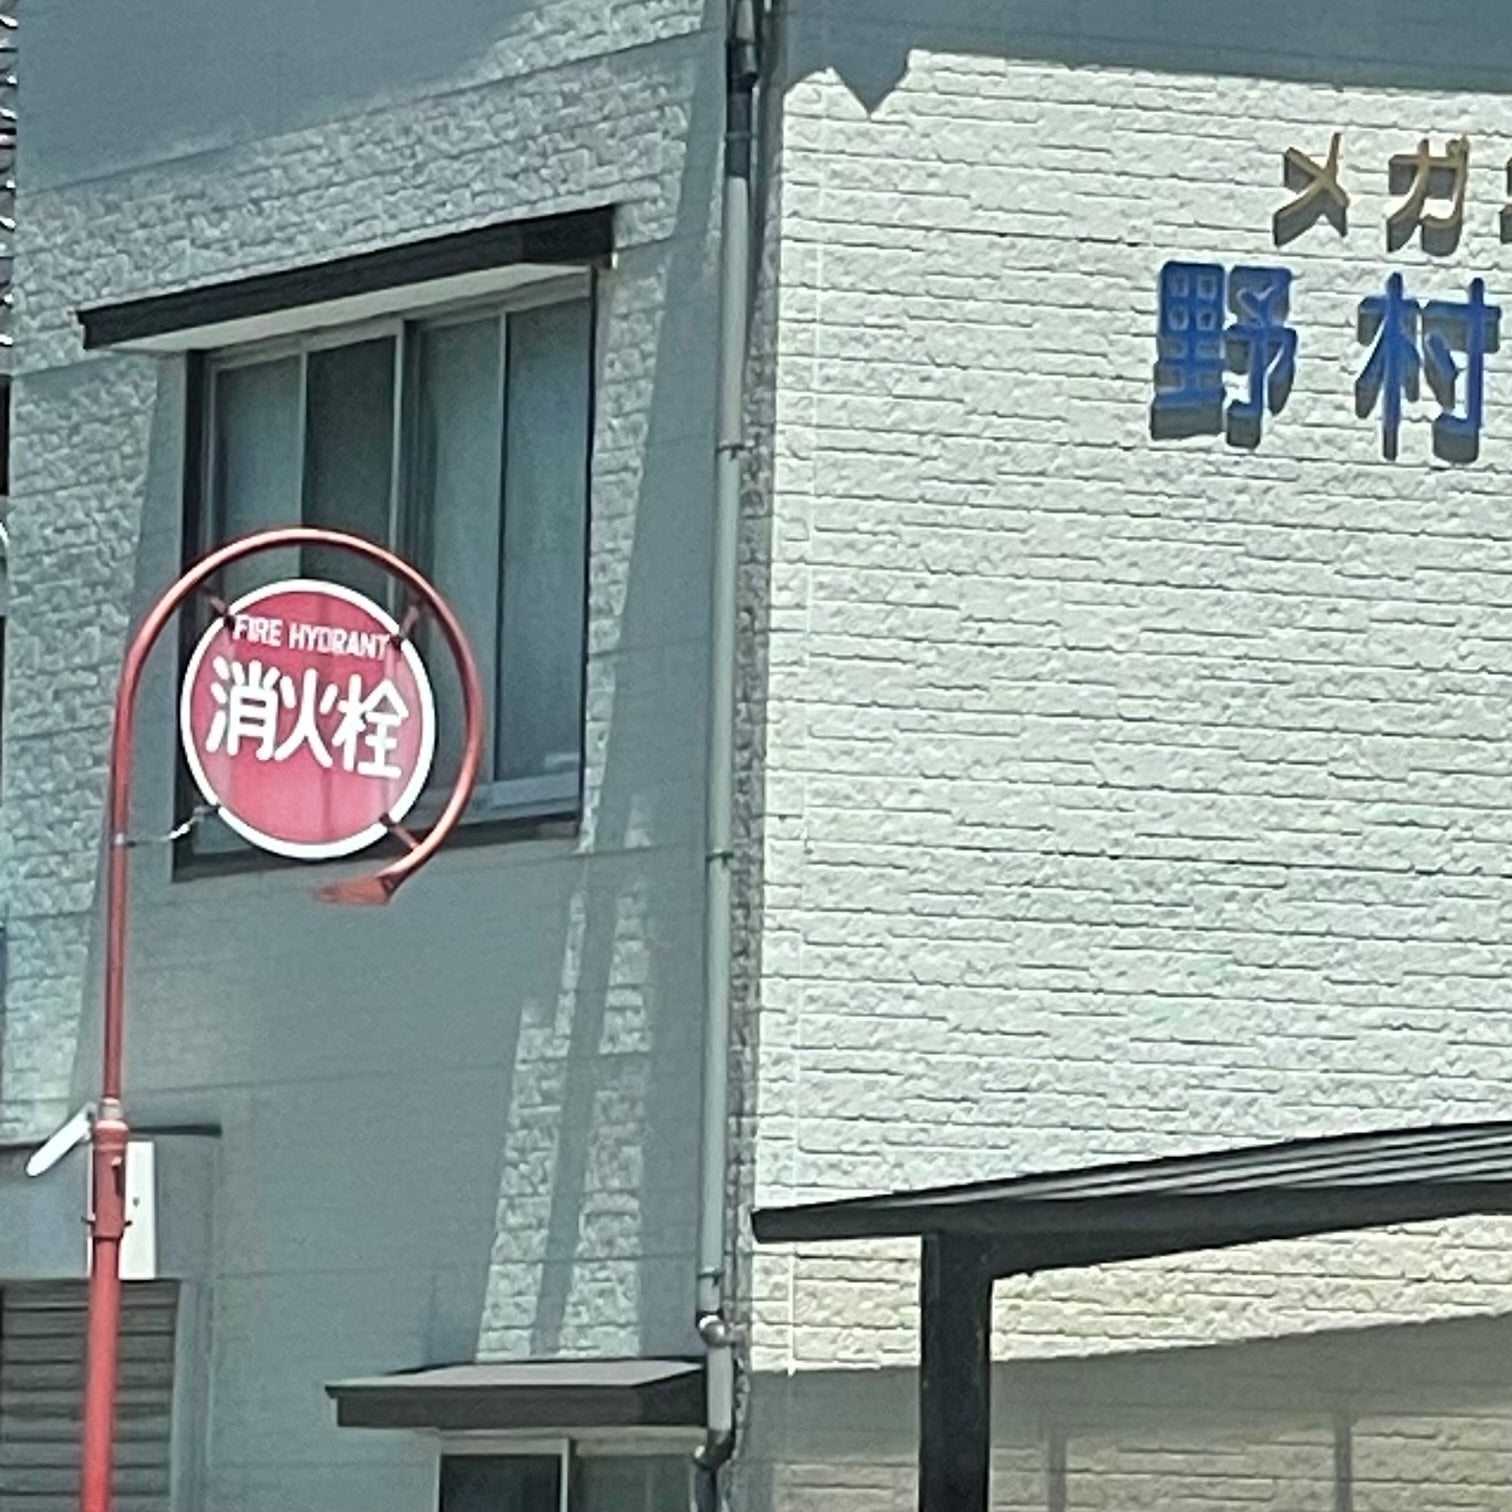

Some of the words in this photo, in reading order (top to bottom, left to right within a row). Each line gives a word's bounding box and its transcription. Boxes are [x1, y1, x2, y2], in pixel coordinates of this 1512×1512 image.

[232, 614, 283, 648] FIRE
[288, 623, 391, 661] HYDRANT
[205, 655, 409, 780] 消火栓
